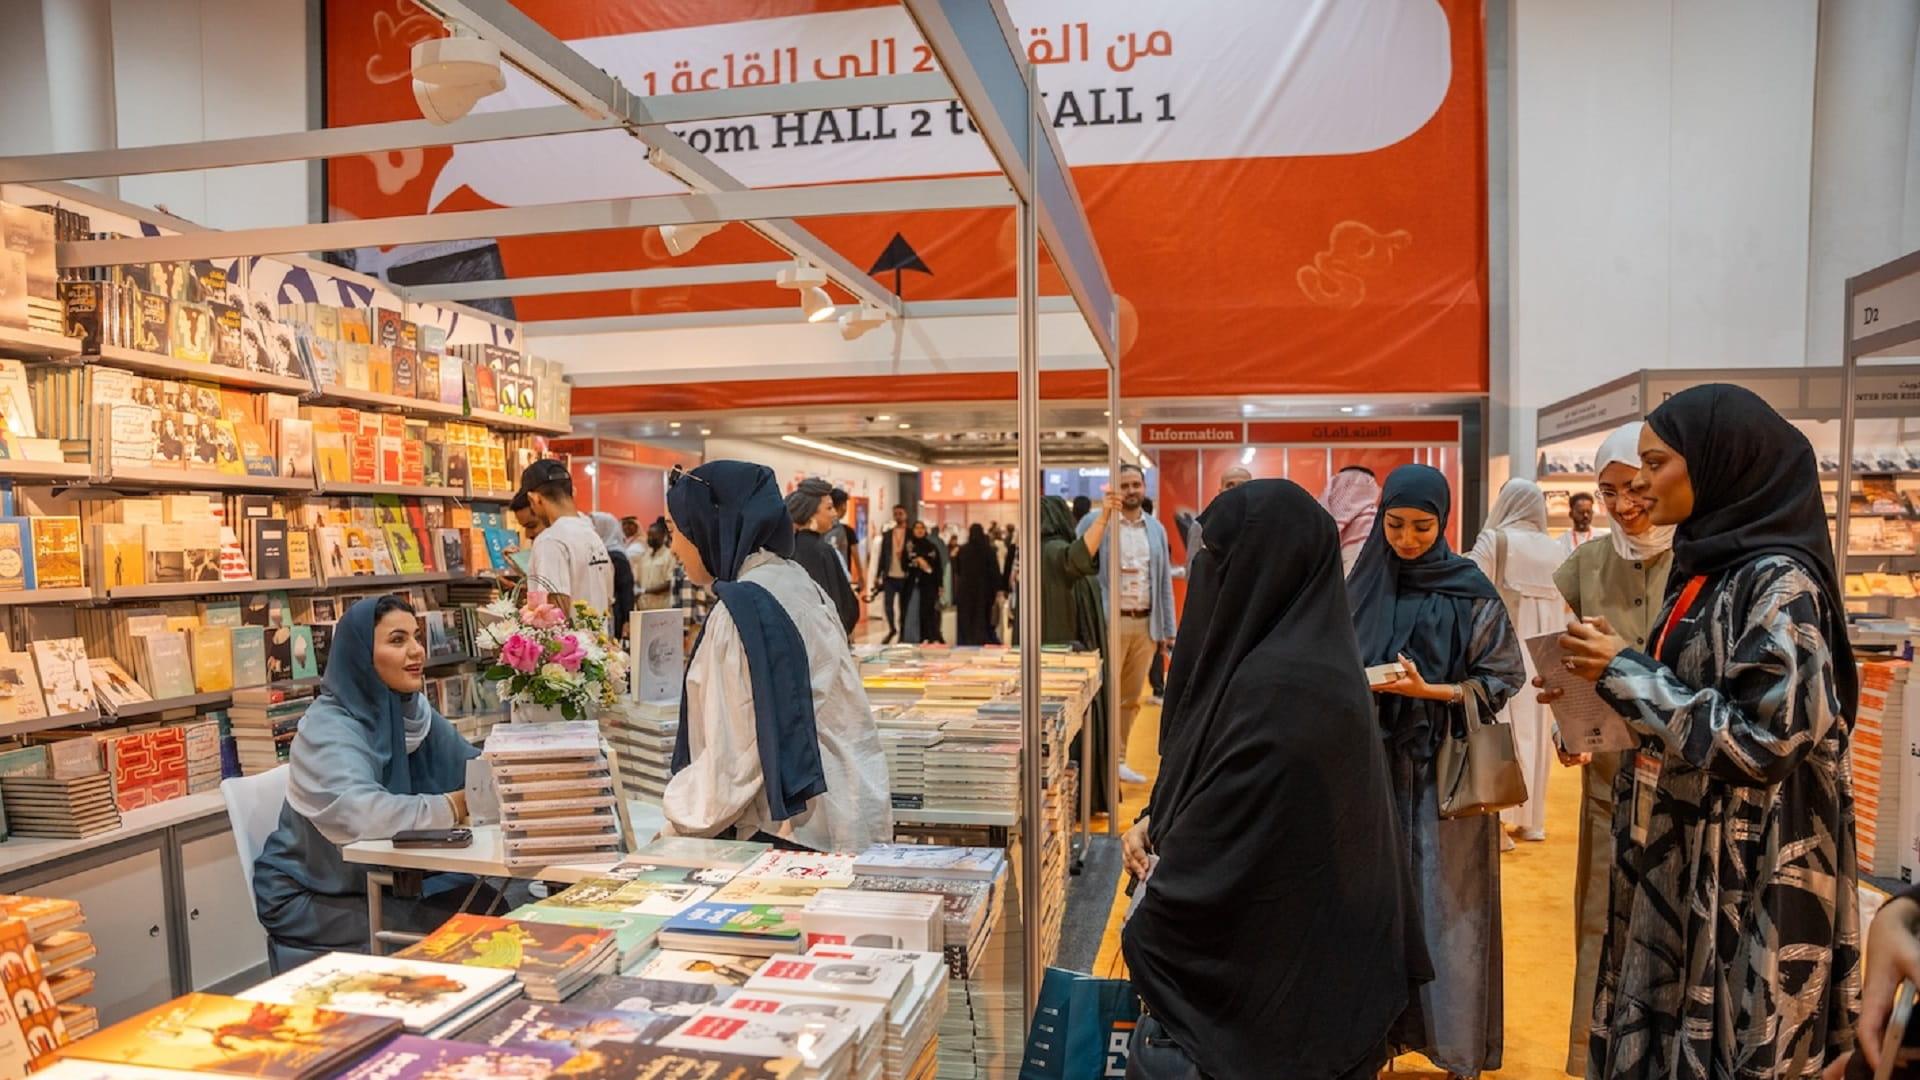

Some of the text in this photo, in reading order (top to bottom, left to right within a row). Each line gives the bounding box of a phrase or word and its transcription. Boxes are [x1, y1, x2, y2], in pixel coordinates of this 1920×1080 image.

[912, 45, 935, 72] 2
[1106, 29, 1172, 72] من
[671, 47, 797, 93] القاعة
[643, 72, 656, 96] 1
[772, 105, 897, 148] HALL
[910, 108, 932, 137] 2
[1041, 87, 1142, 128] ALL
[1155, 92, 1176, 122] 1
[1863, 306, 1879, 325] D2
[1149, 427, 1235, 441] Information
